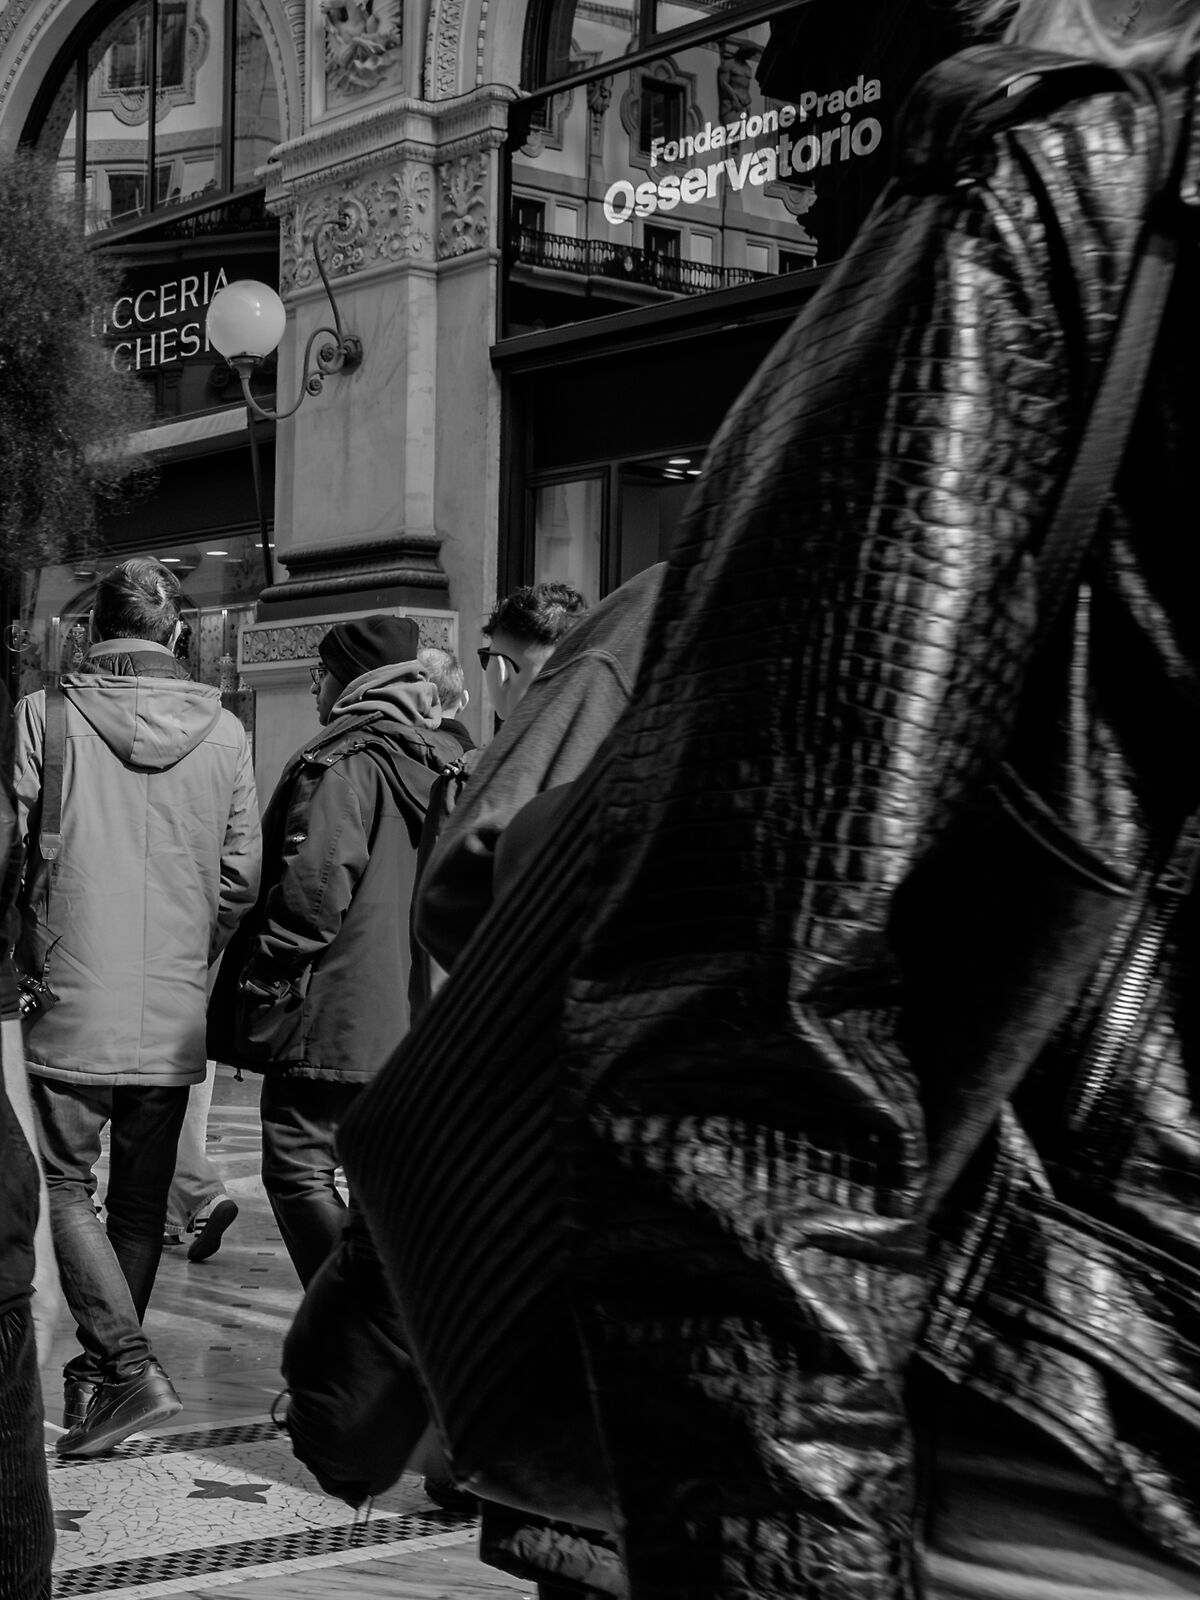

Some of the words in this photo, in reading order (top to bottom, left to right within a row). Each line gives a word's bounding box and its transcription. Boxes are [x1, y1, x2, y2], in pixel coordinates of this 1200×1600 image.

[604, 112, 882, 225] Osservatorio
[650, 104, 795, 168] Fondazione
[800, 74, 882, 122] Prada
